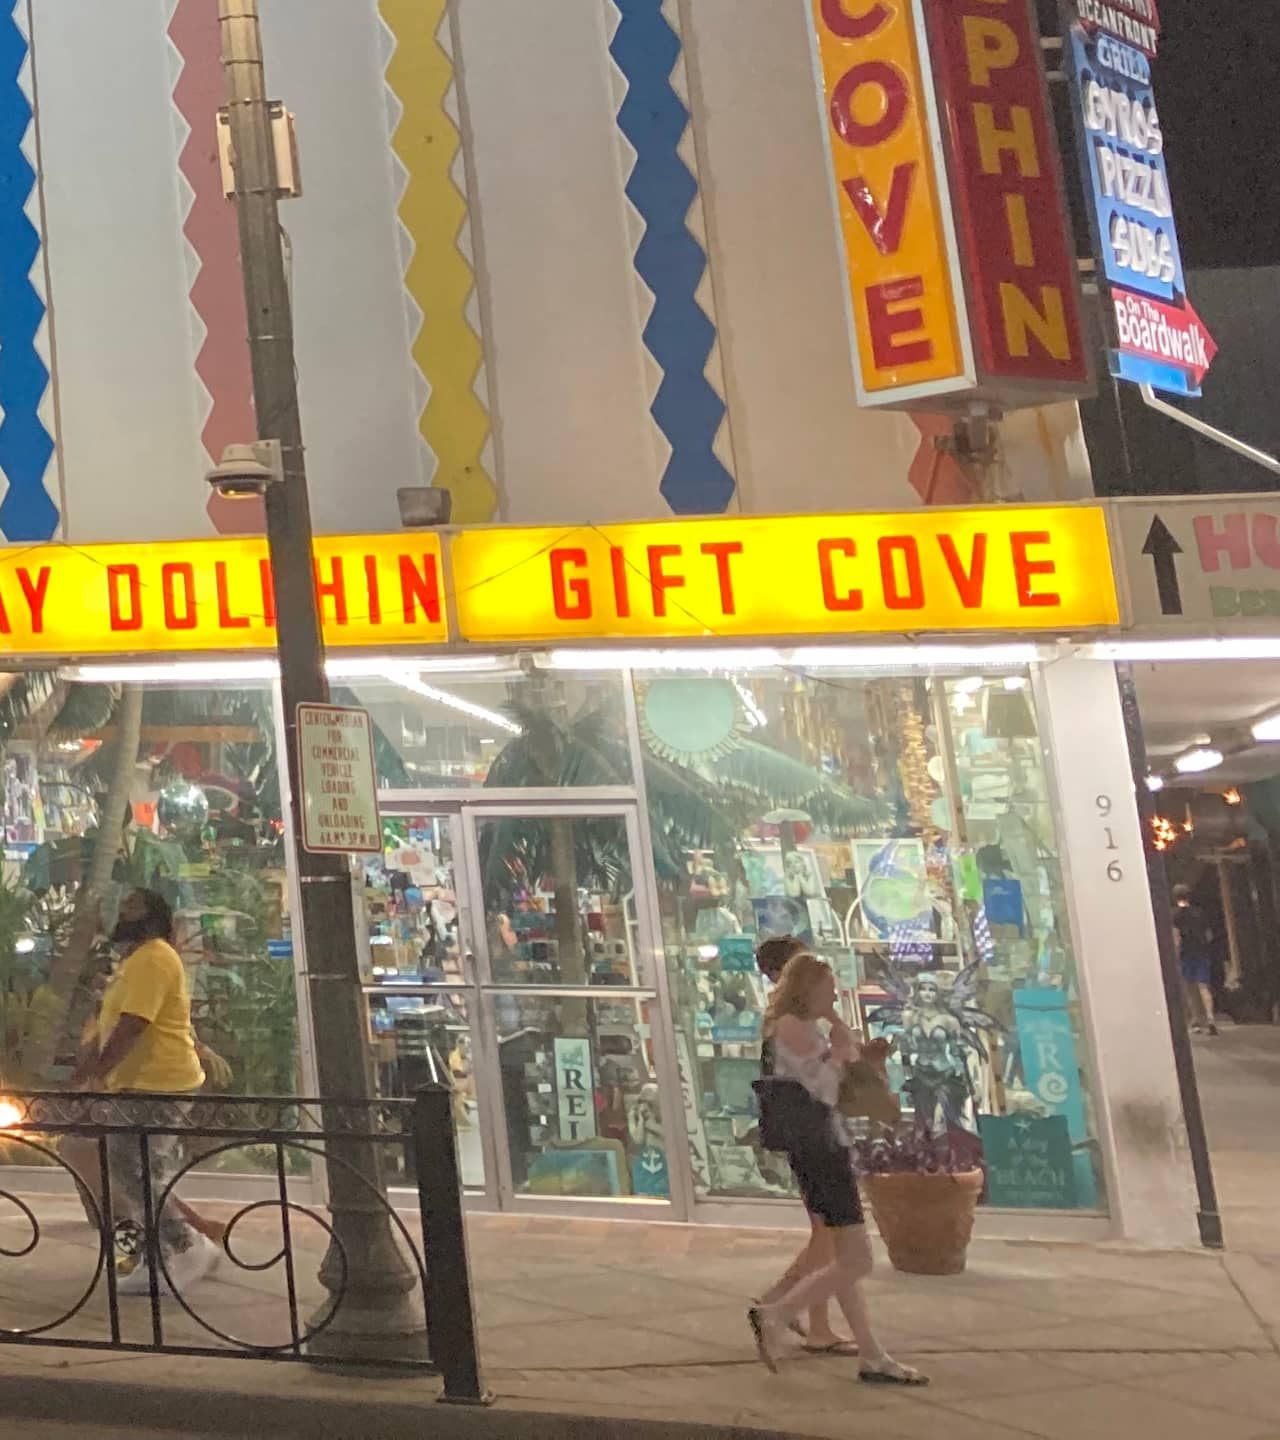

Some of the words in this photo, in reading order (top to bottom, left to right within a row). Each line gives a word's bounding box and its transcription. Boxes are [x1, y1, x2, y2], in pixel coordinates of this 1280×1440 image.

[1085, 79, 1163, 155] GYROS
[1097, 145, 1172, 218] PIZZA
[1111, 215, 1176, 283] SUBS
[1126, 295, 1140, 314] On
[1141, 299, 1162, 324] The
[1114, 300, 1210, 369] Boardwalk
[549, 542, 743, 621] GIFT
[816, 531, 1062, 612] COVE
[312, 745, 360, 762] COMMERCIAL
[320, 762, 353, 777] VEHICLE
[321, 779, 356, 795] LOADING
[332, 797, 348, 811] AND
[318, 814, 365, 829] UNLOADING
[1095, 794, 1123, 882] 916
